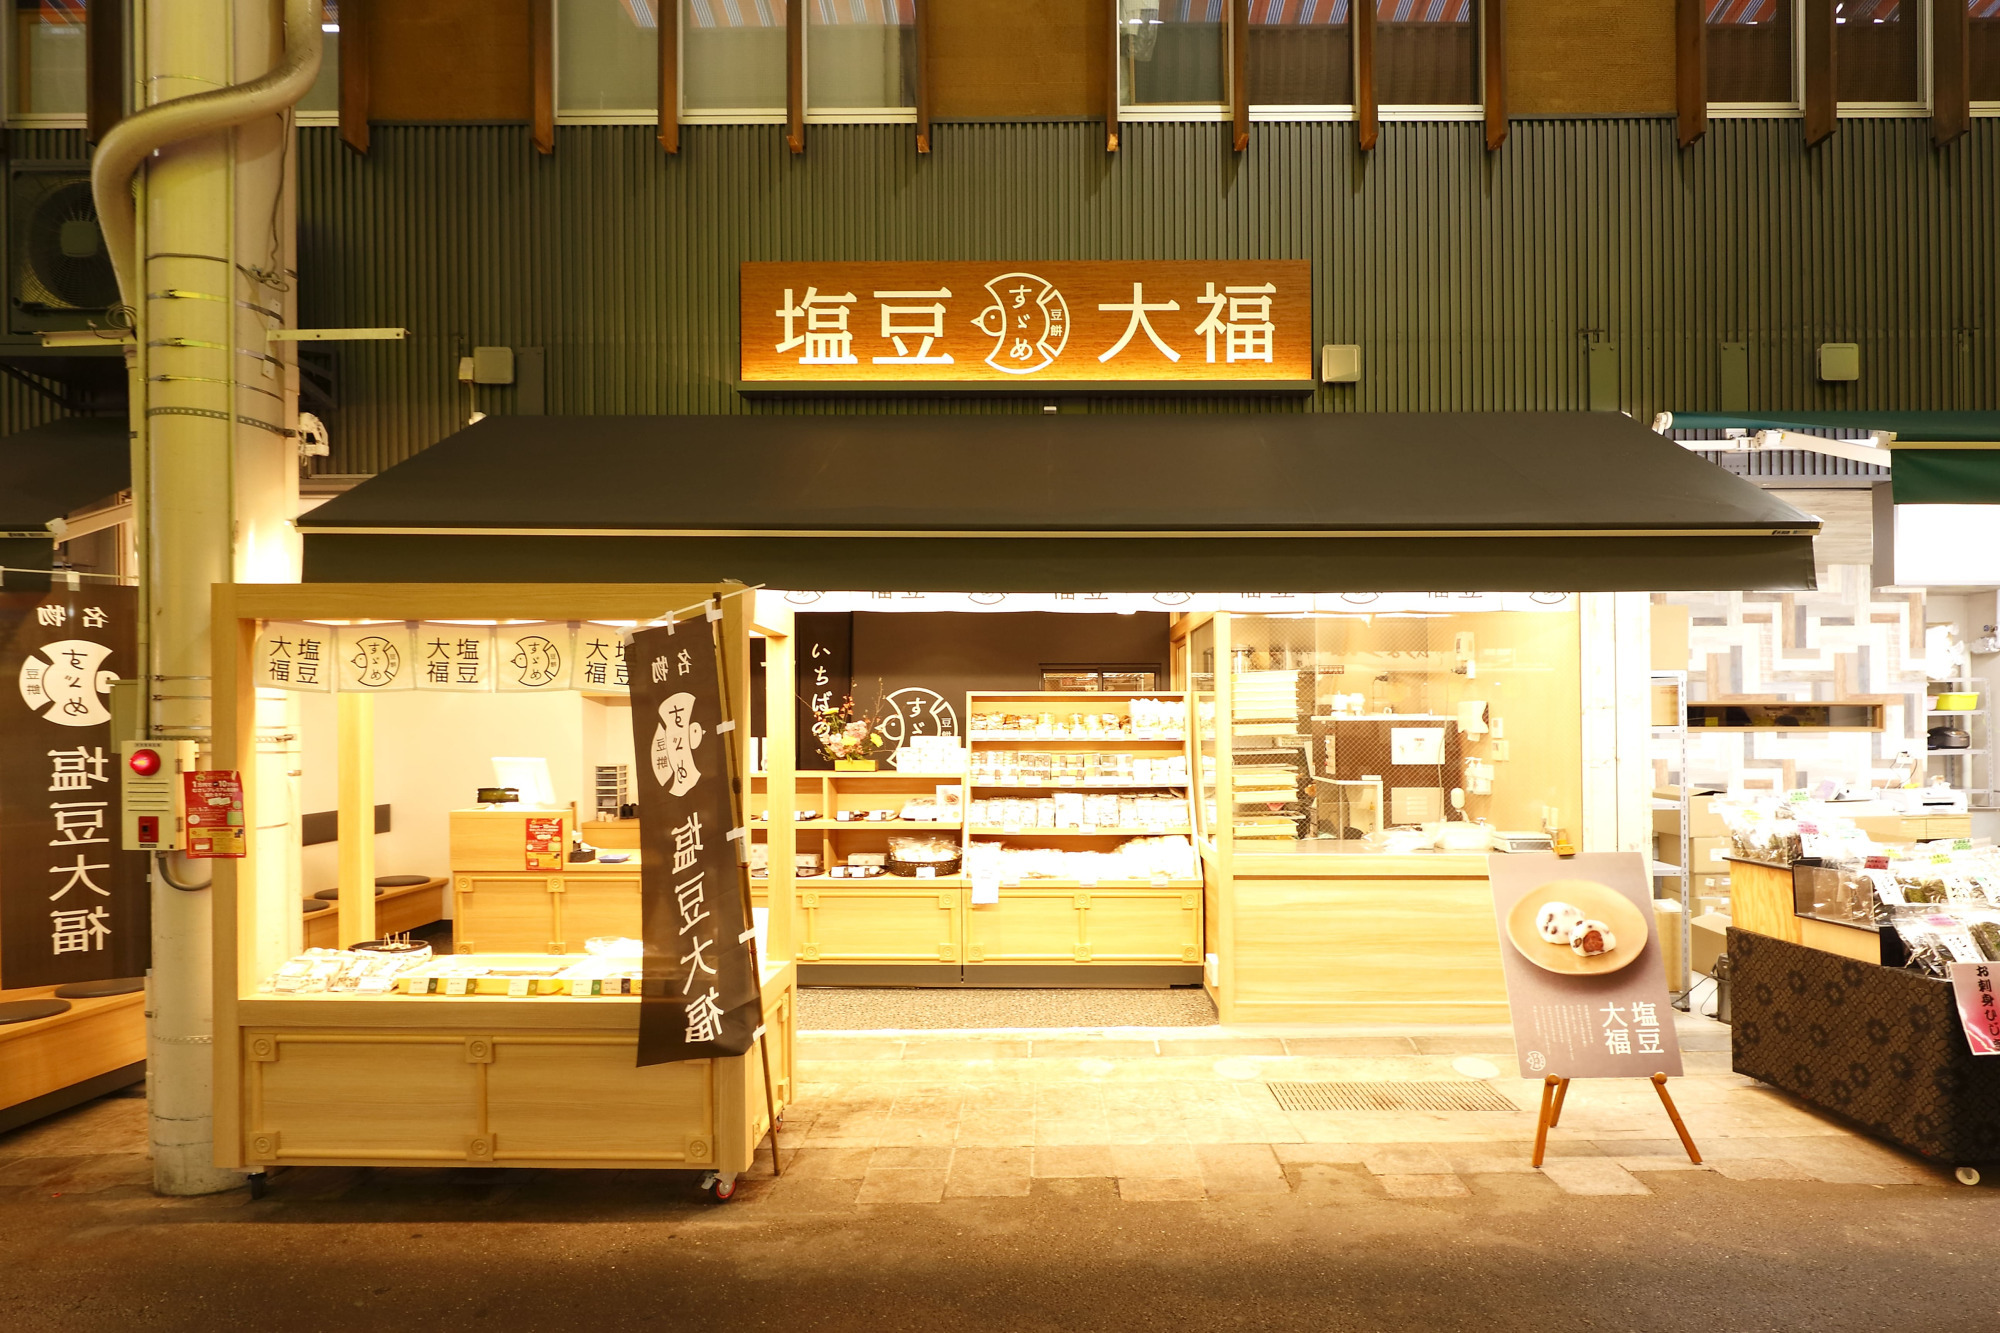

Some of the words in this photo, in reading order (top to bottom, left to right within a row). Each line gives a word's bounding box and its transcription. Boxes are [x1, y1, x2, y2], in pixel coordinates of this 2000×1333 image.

[775, 286, 954, 365] 塩豆
[1097, 282, 1279, 363] 大福
[268, 635, 291, 681] 大福
[297, 637, 322, 686] 塩豆
[426, 637, 450, 683] 大福
[456, 637, 480, 685] 塩豆
[584, 638, 609, 684] 大福
[1599, 1001, 1632, 1055] 大福
[1630, 1001, 1665, 1054] 塩豆
